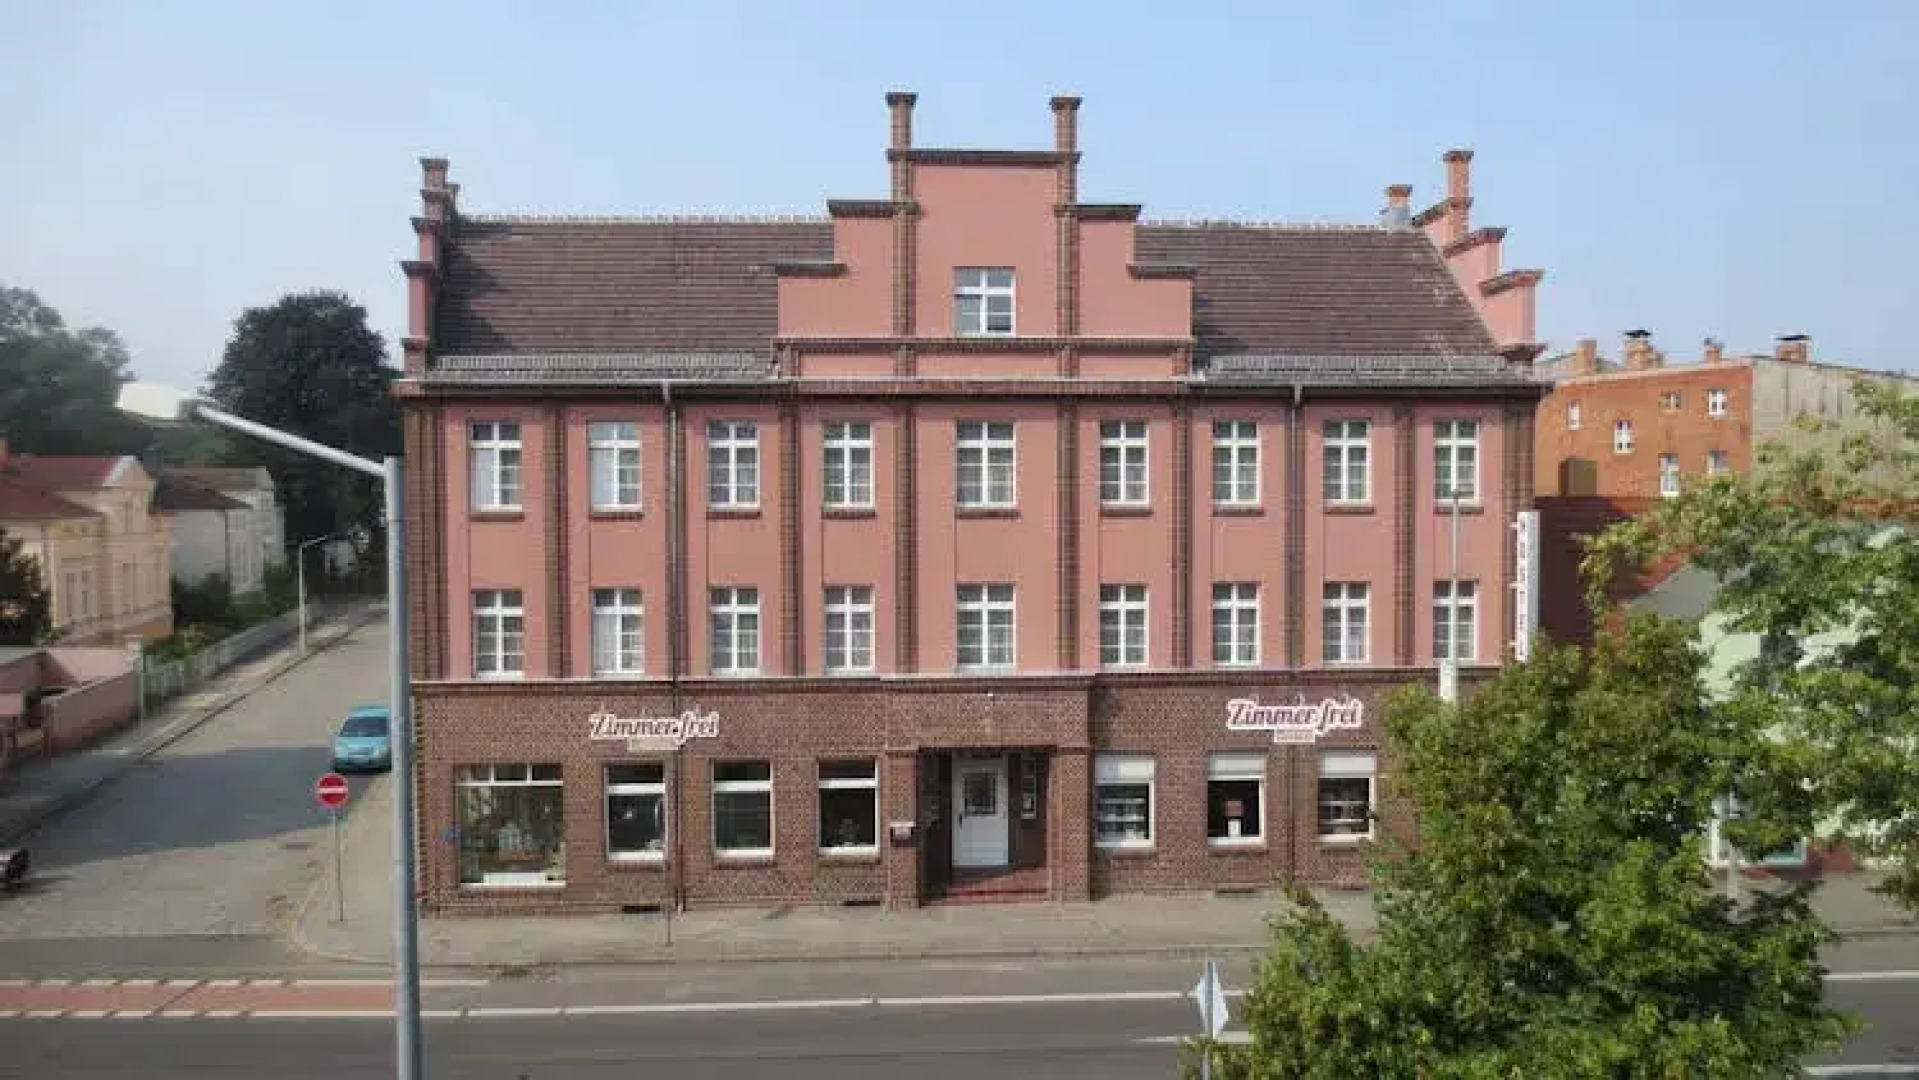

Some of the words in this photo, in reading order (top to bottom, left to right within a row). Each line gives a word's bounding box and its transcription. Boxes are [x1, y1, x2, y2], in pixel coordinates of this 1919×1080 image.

[589, 713, 677, 740] Zimmer
[678, 711, 719, 745] frei
[1227, 699, 1317, 730] Zimmer
[1318, 699, 1361, 735] frei
